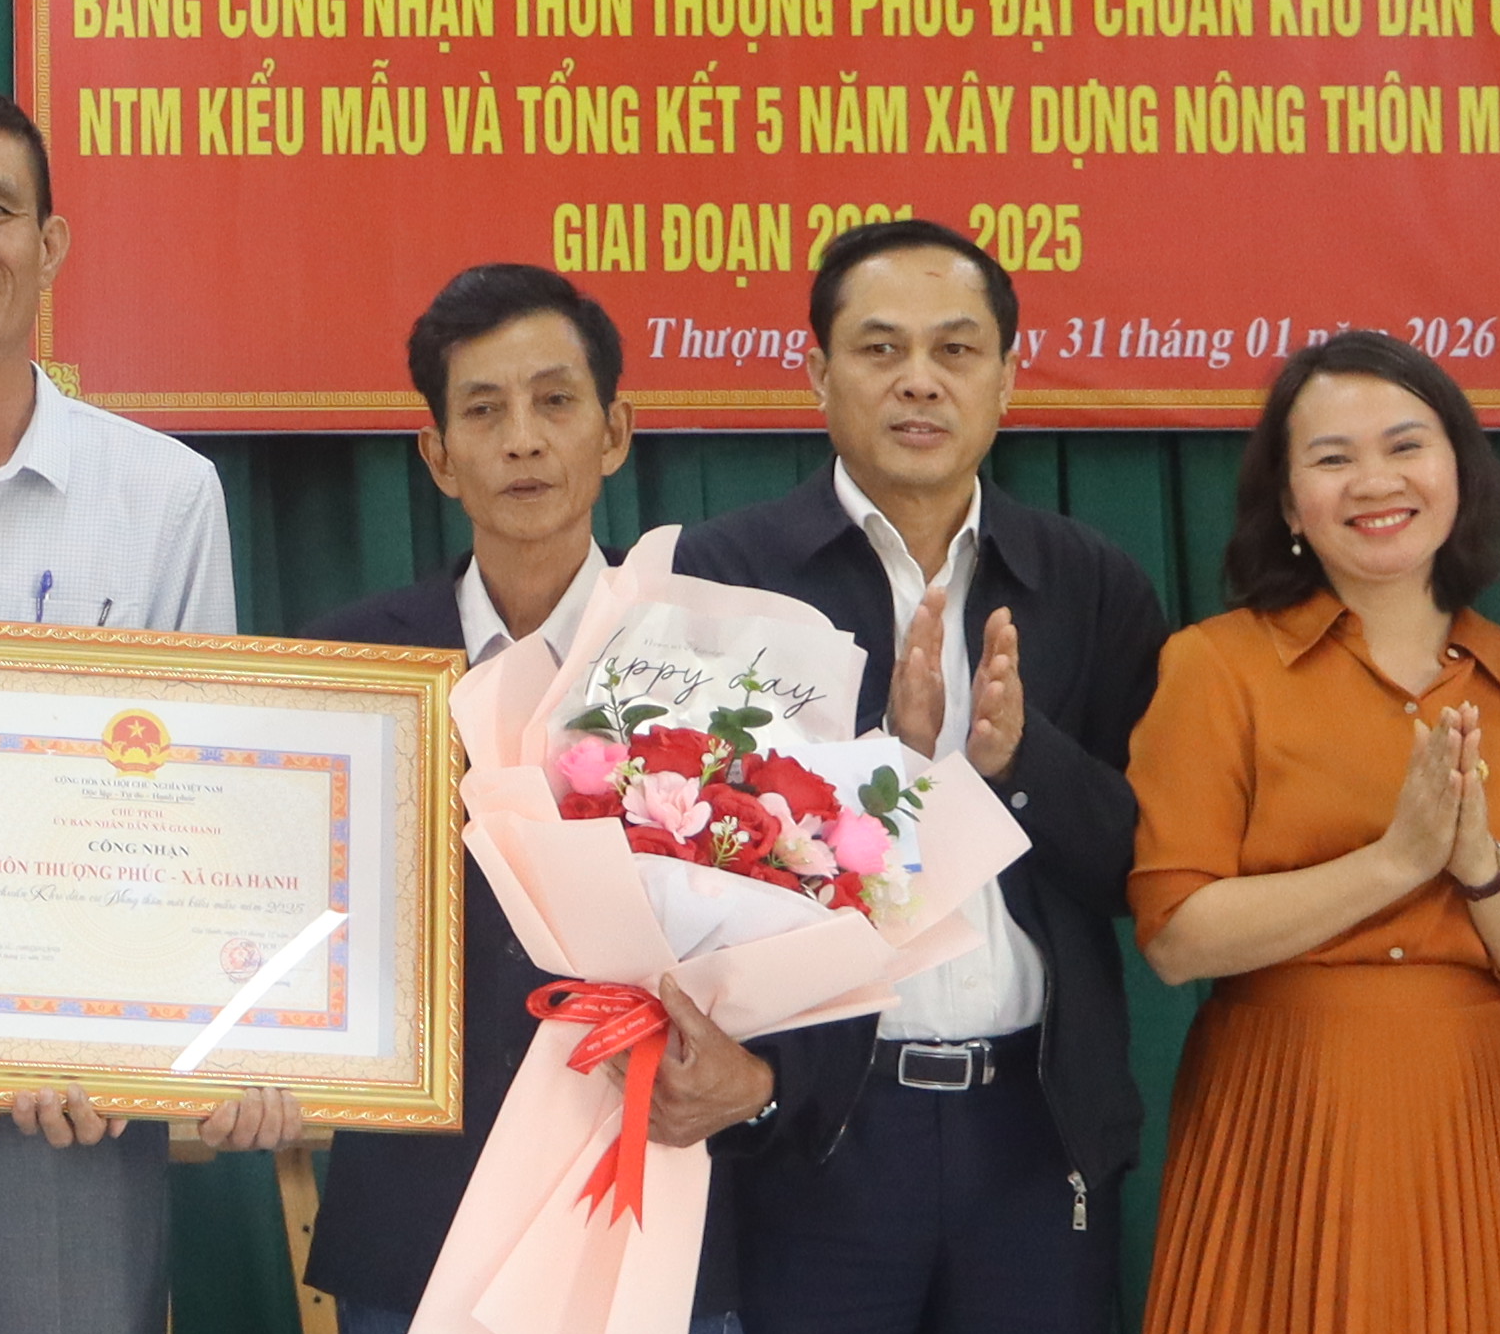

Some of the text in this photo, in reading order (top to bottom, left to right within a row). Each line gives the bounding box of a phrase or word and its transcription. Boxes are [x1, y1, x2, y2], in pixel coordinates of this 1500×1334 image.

[79, 87, 182, 157] NTM
[198, 57, 305, 156] KIỂU
[321, 58, 427, 156] MẪU
[442, 70, 504, 155] VÀ
[516, 57, 640, 155] TỔNG
[656, 60, 741, 154] KẾT
[756, 86, 784, 155] 5
[799, 70, 908, 154] NĂM
[923, 70, 1015, 154] XÂY
[1030, 78, 1159, 170] DỰNG
[1174, 70, 1306, 155] NÔNG
[1319, 70, 1443, 155] THÔN
[553, 202, 646, 273] GIAI
[661, 202, 792, 288] ĐOẠN
[968, 202, 1082, 272] 2025
[647, 317, 808, 369] Thượng
[1059, 317, 1105, 358] 31
[1119, 318, 1234, 369] tháng
[1246, 316, 1290, 358] 01
[1406, 316, 1498, 358] 2026
[204, 785, 224, 794] NAM
[70, 819, 91, 828] BAN
[169, 824, 189, 834] GIA
[137, 809, 164, 820] TỊCH
[88, 839, 137, 854] CÔNG
[34, 860, 112, 881] THƯỢNG
[118, 864, 166, 883] PHÚC
[182, 868, 205, 885] XÃ
[211, 872, 243, 888] GIA
[248, 874, 299, 891] HANH
